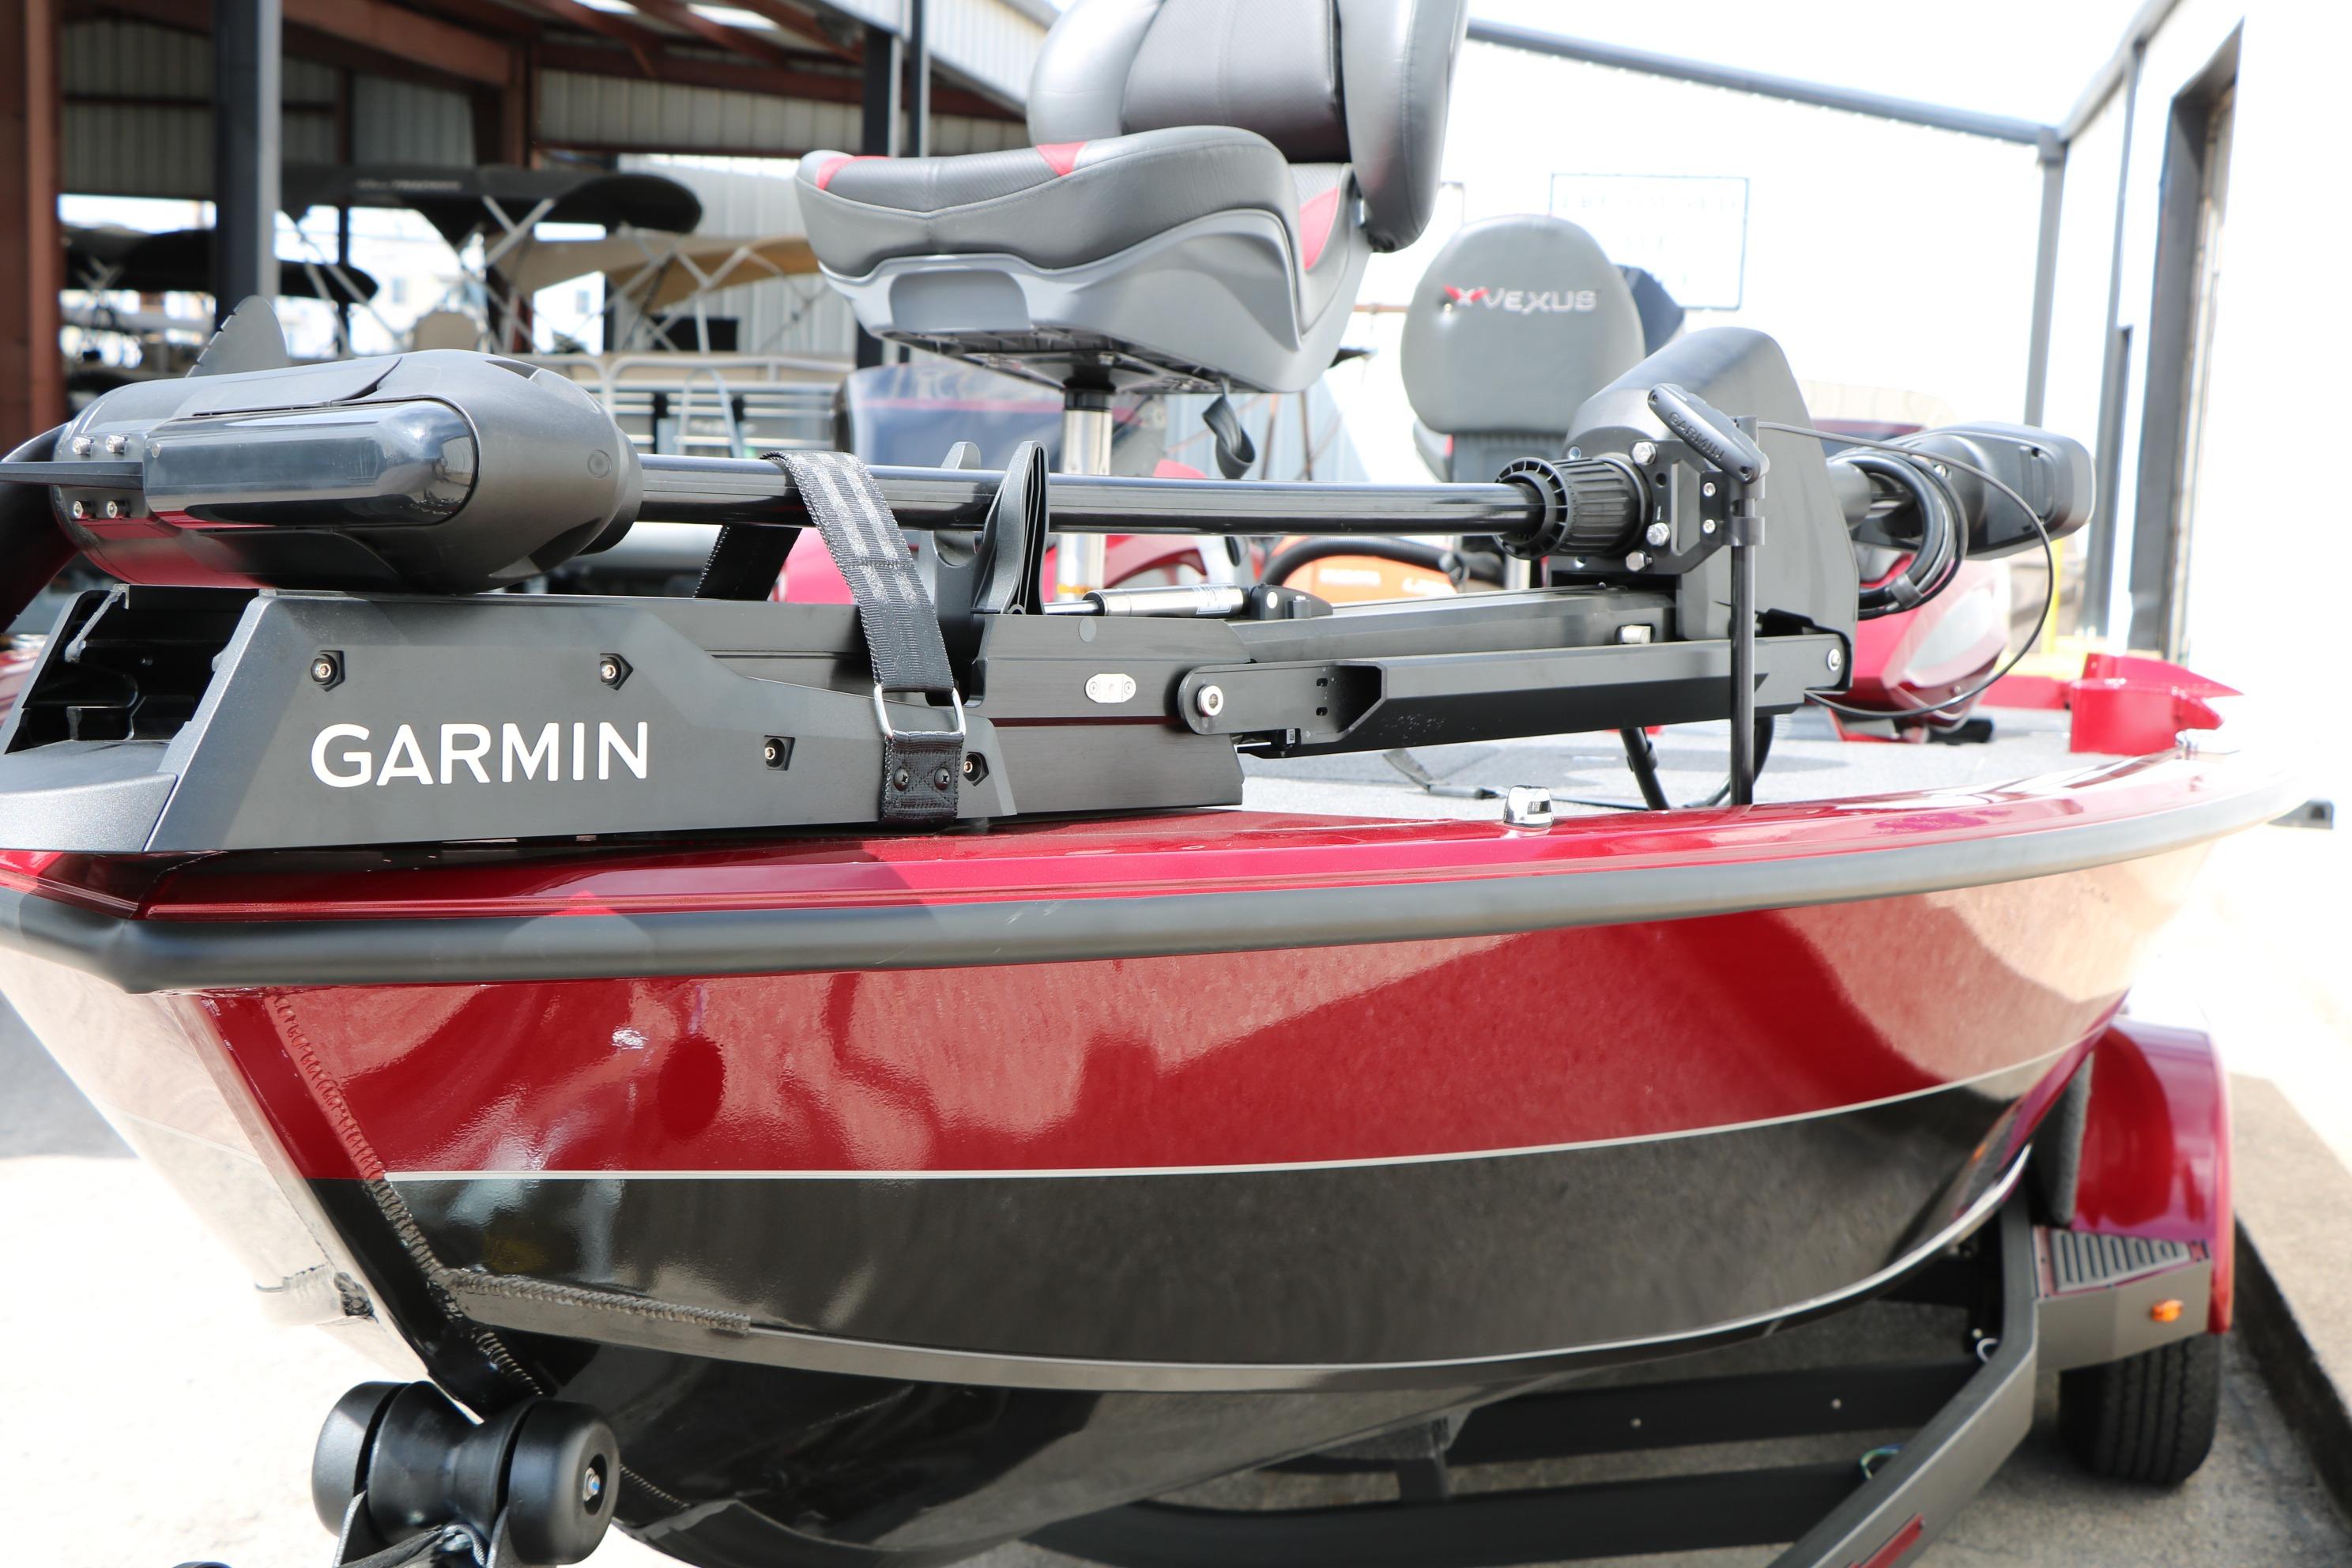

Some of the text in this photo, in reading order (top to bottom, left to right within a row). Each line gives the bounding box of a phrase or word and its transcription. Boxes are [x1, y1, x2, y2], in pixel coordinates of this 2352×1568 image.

[1483, 287, 1597, 315] VEXUS
[1668, 411, 1725, 462] GARMIN
[311, 722, 648, 788] GARMIN
